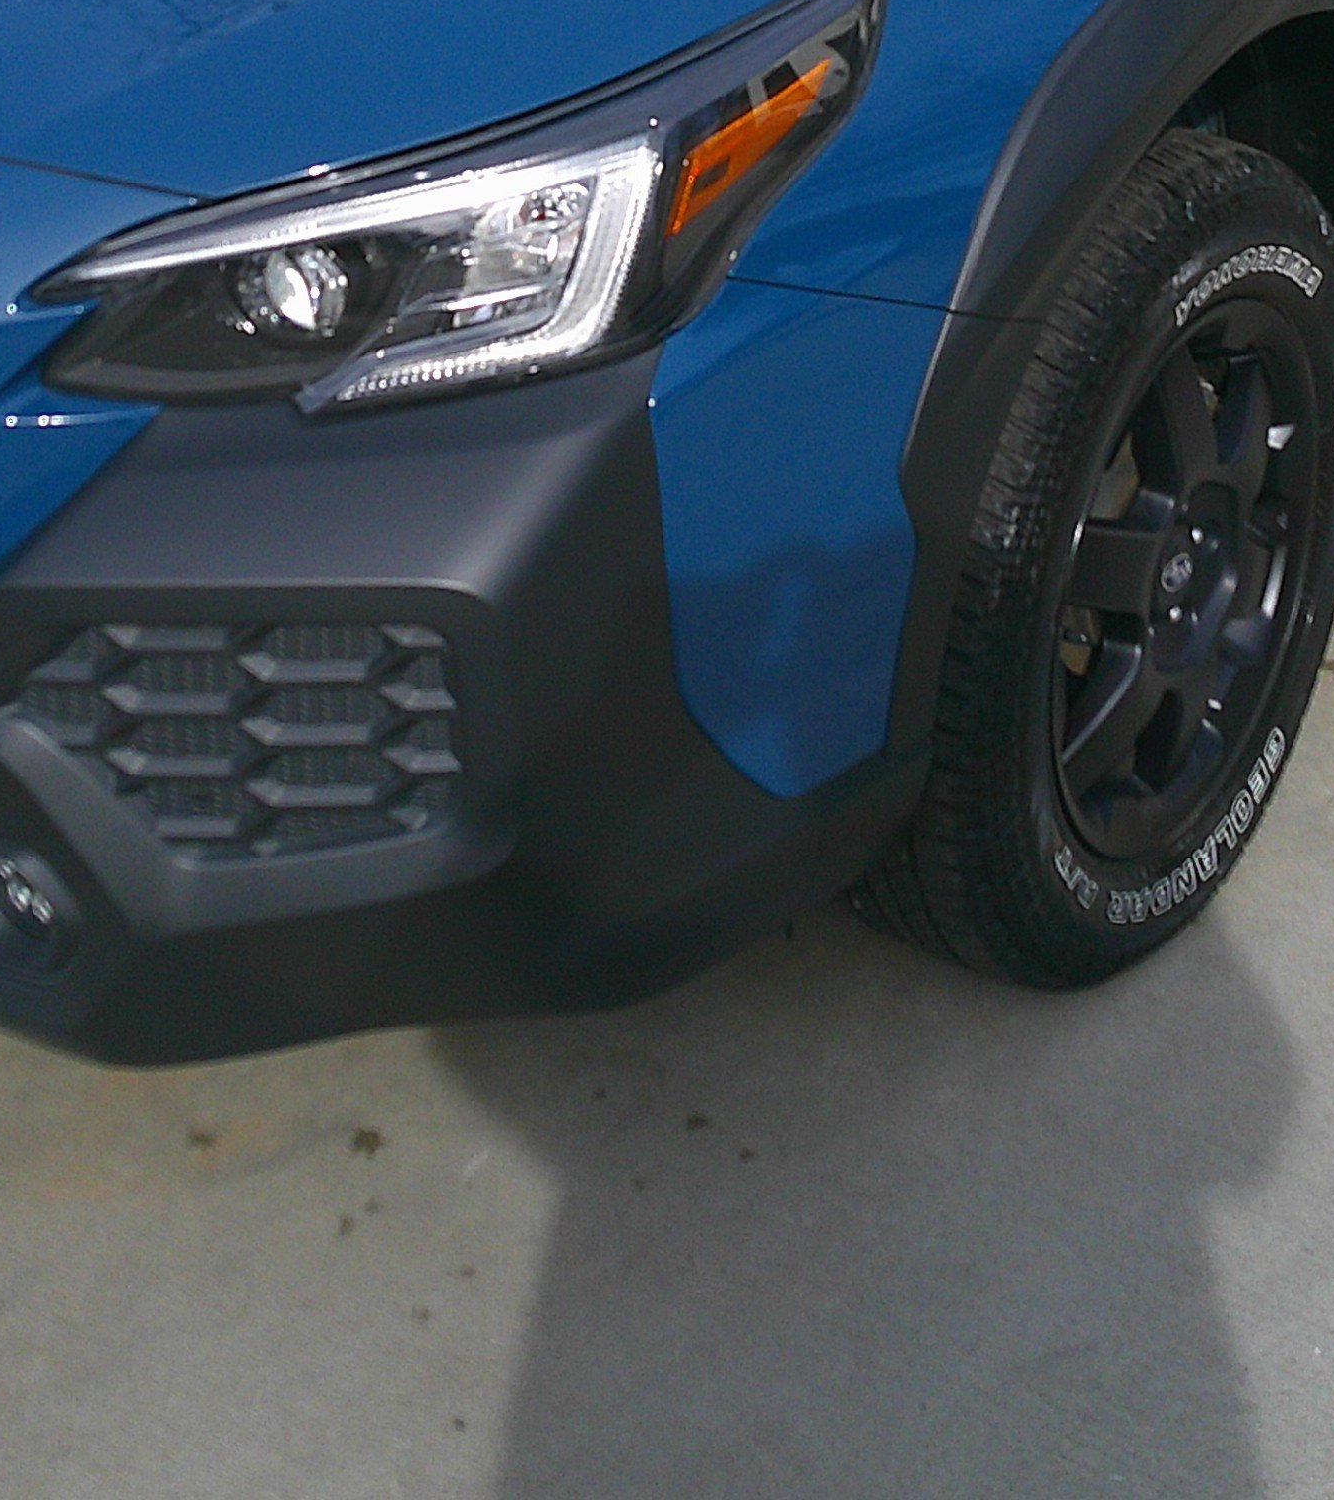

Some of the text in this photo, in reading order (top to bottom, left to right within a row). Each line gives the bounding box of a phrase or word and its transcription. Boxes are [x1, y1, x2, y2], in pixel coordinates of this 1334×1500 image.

[1174, 245, 1324, 328] YOKOHAMA
[1054, 726, 1286, 924] GEOLANDAR A/T
